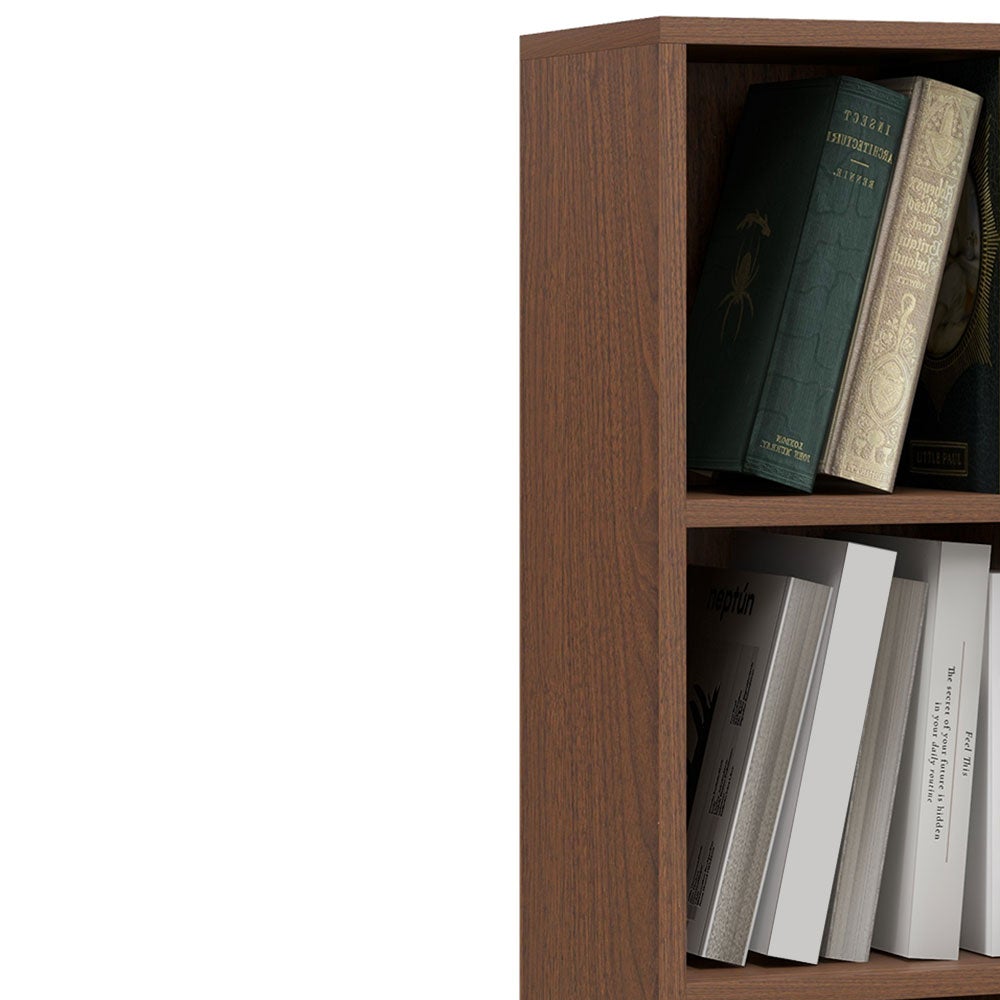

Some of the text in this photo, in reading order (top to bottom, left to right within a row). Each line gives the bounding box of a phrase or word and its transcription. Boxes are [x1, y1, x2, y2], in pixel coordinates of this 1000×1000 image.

[705, 581, 756, 623] neptún
[927, 702, 942, 803] in your daily routine
[934, 666, 956, 840] The secret of your future is hidden
[962, 730, 973, 777] Feel This
